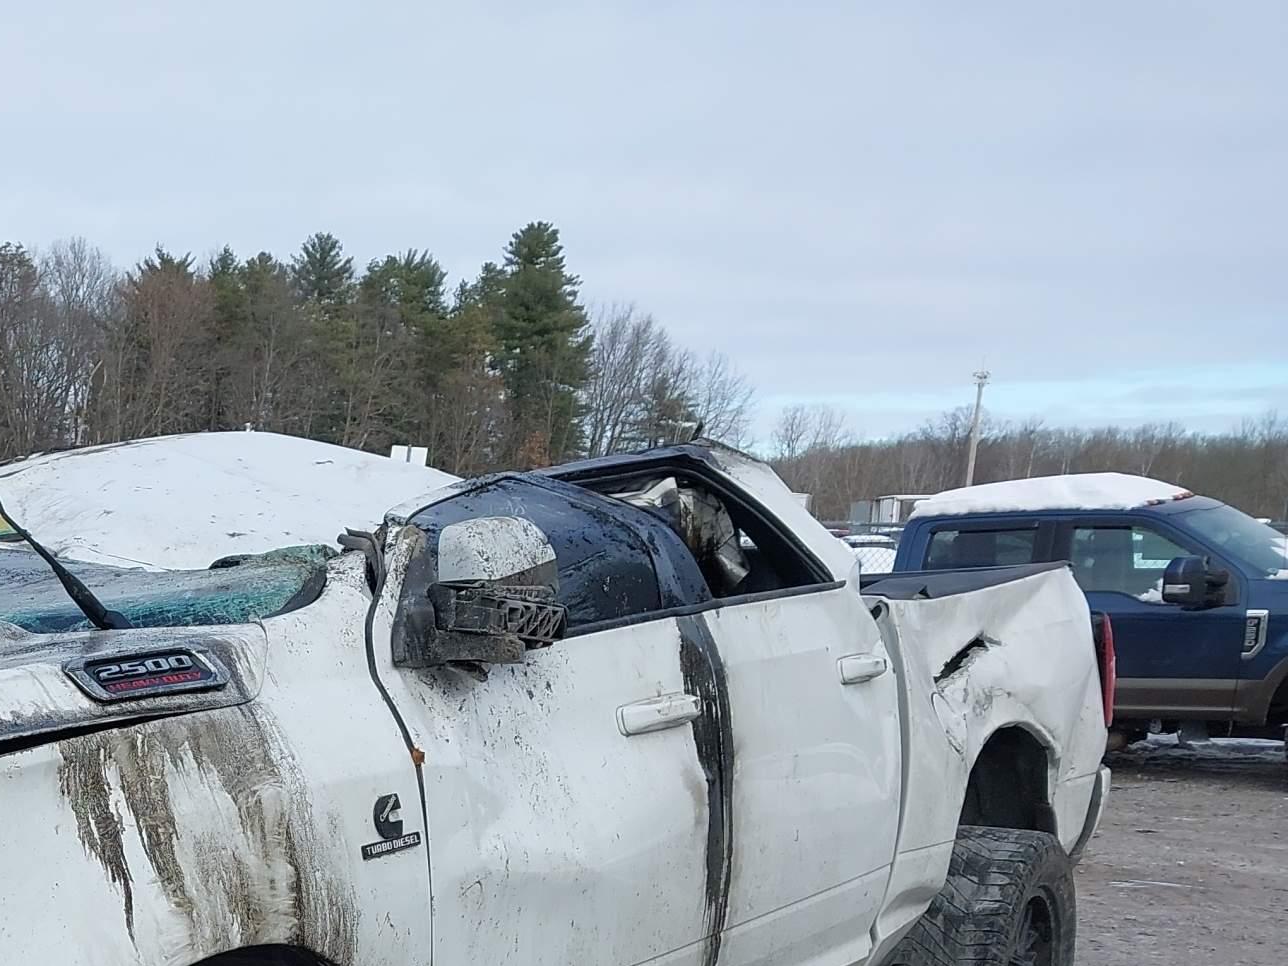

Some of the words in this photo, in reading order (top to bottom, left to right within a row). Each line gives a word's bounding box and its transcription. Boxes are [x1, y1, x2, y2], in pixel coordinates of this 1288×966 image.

[93, 655, 193, 681] 2500
[105, 677, 160, 693] HEAVY
[161, 671, 201, 683] DUTY
[366, 841, 393, 856] TURBO
[392, 834, 420, 849] DIESEL
